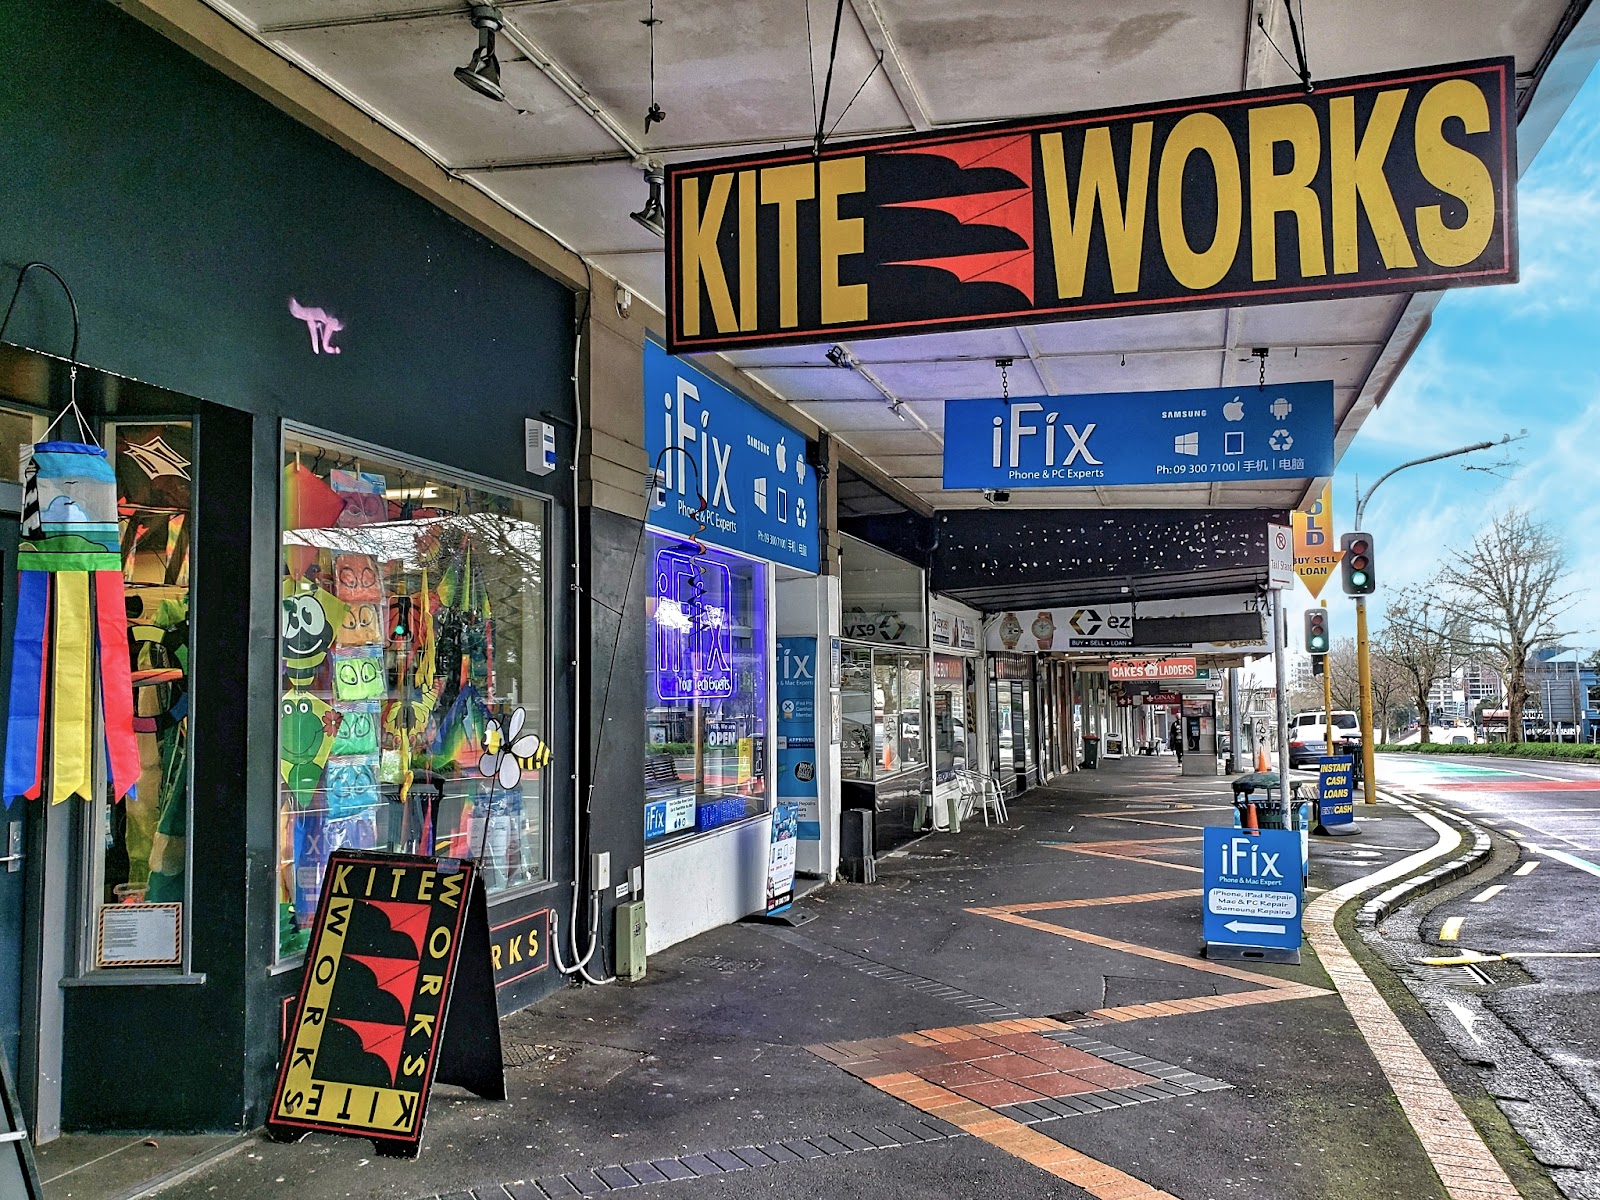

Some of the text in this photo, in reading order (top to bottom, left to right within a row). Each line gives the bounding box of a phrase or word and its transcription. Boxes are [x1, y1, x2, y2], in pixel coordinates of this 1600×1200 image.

[683, 79, 1496, 336] KITE WORKS
[1161, 409, 1207, 419] SAMSUNG
[992, 402, 1103, 468] iFix
[664, 375, 736, 514] iFix
[746, 434, 770, 456] SAMSUNG
[1156, 462, 1235, 475] Ph: 09 300 7100
[1243, 458, 1305, 473] 手机 电脑
[1008, 468, 1104, 480] Phone & PC Experts
[706, 509, 715, 527] PC
[715, 512, 737, 533] Experts
[1304, 501, 1325, 546] OLD
[1314, 556, 1337, 564] SELL
[1300, 566, 1327, 576] LOAN
[1243, 600, 1267, 611] 177
[1111, 665, 1144, 678] CAKES
[1159, 664, 1195, 676] LADDERS
[709, 731, 736, 746] OPEN
[1320, 762, 1352, 773] INSTANT
[1325, 776, 1347, 786] CASH
[1323, 788, 1349, 799] LOANS
[646, 806, 665, 831] iFix
[1221, 837, 1284, 878] iFix
[332, 864, 437, 901] KITE
[1219, 875, 1283, 886] Phone & Mac Expert
[1245, 891, 1263, 899] iPad
[1264, 893, 1294, 901] Repair
[1215, 905, 1256, 914] Samsung
[1260, 900, 1289, 908] Repair
[491, 928, 539, 971] RKS
[402, 872, 464, 1077] WORKS
[284, 904, 349, 1114] WORKS
